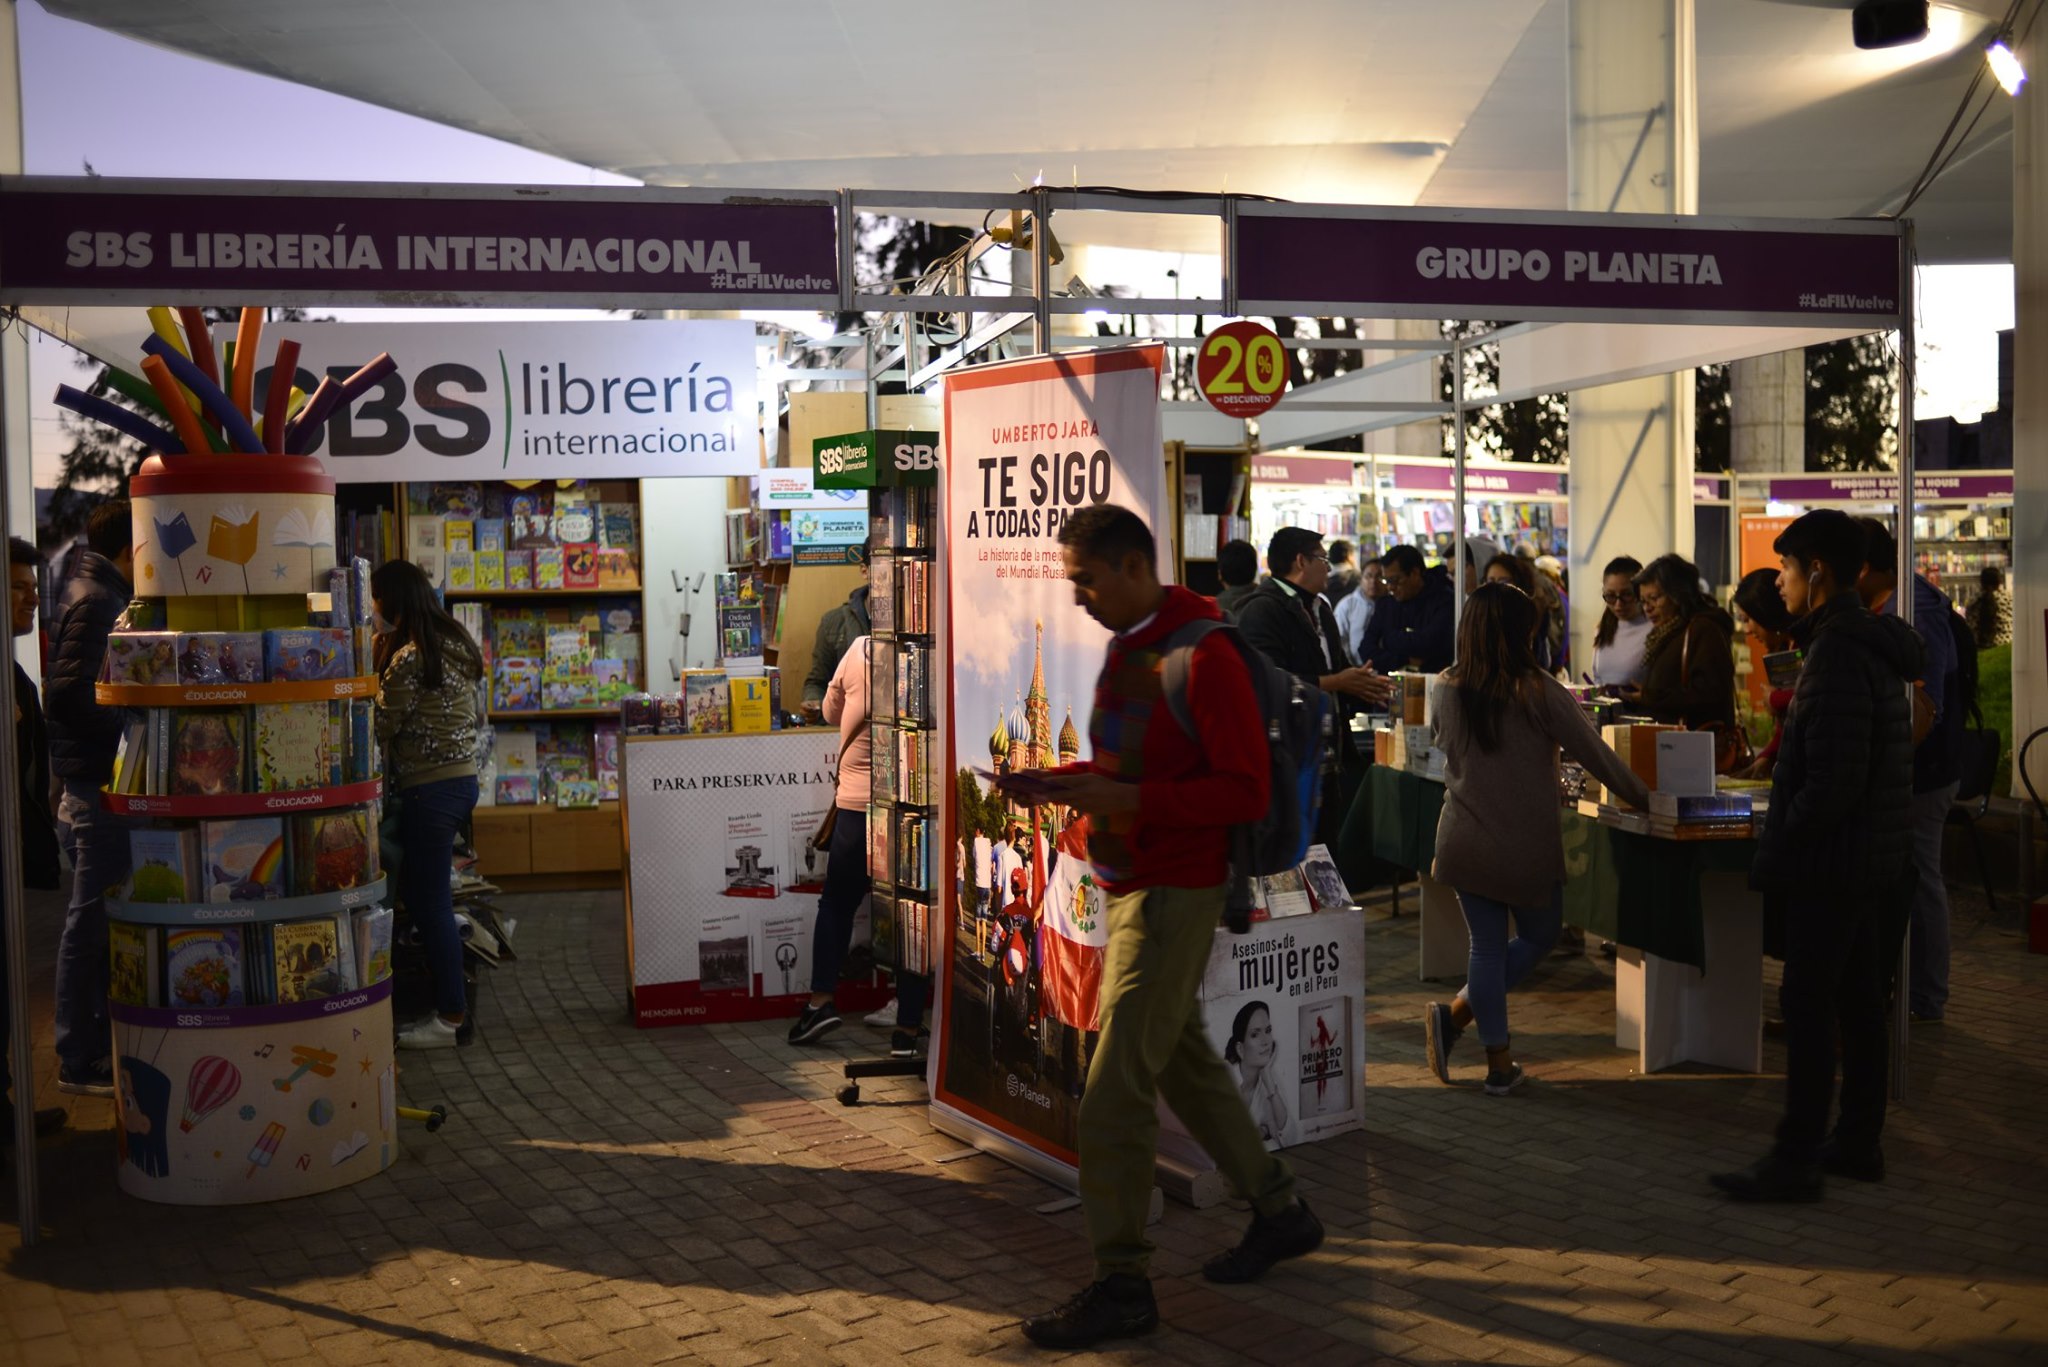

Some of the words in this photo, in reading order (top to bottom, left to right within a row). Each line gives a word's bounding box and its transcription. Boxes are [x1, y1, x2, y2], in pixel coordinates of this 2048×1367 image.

[66, 231, 153, 268] SBS
[170, 223, 382, 270] LIBRERÍA
[397, 235, 761, 274] INTERNACIONAL
[1416, 247, 1551, 281] GRUPO
[1564, 250, 1723, 285] PLANETA
[711, 273, 832, 291] #LaFILVuelve
[1799, 293, 1894, 309] #LaFILVuelve
[523, 362, 733, 415] librería
[1223, 395, 1272, 404] DESCUENTO
[524, 425, 735, 455] internacional
[992, 423, 1058, 444] UMBERTO
[1061, 419, 1099, 439] JARA
[820, 446, 843, 475] SBS
[844, 442, 868, 461] librería
[979, 456, 1018, 508] TE
[1030, 449, 1111, 507] SIGO
[1831, 479, 1876, 488] PENGUIN
[1879, 478, 1924, 487] RANM
[1926, 478, 1960, 487] HOUSE
[1851, 489, 1886, 499] GRUPO
[967, 510, 979, 538] A
[985, 508, 1041, 538] TODAS
[978, 548, 988, 561] La
[991, 547, 1018, 561] historia
[1021, 548, 1032, 561] de
[996, 565, 1008, 578] del
[1010, 564, 1040, 578] Mundial
[728, 613, 751, 621] Oxford
[730, 620, 752, 629] Pocket
[333, 683, 353, 695] SBS
[653, 777, 698, 791] PARA
[702, 772, 799, 789] PRESERVAR
[803, 770, 823, 784] LA
[128, 798, 148, 811] SBS
[341, 891, 360, 905] SBS
[1232, 938, 1277, 959] Asesinos
[1283, 933, 1295, 949] de
[1239, 941, 1340, 993] mujeres
[1289, 983, 1300, 997] en
[1304, 978, 1313, 993] el
[1316, 972, 1338, 991] Perú
[177, 1014, 202, 1026] SBS
[640, 1008, 682, 1018] MEMORIA
[683, 1004, 707, 1016] PERÚ
[1301, 1046, 1343, 1065] PRIMERO
[1303, 1060, 1340, 1076] MUERTA
[1020, 1082, 1051, 1109] Planeta
